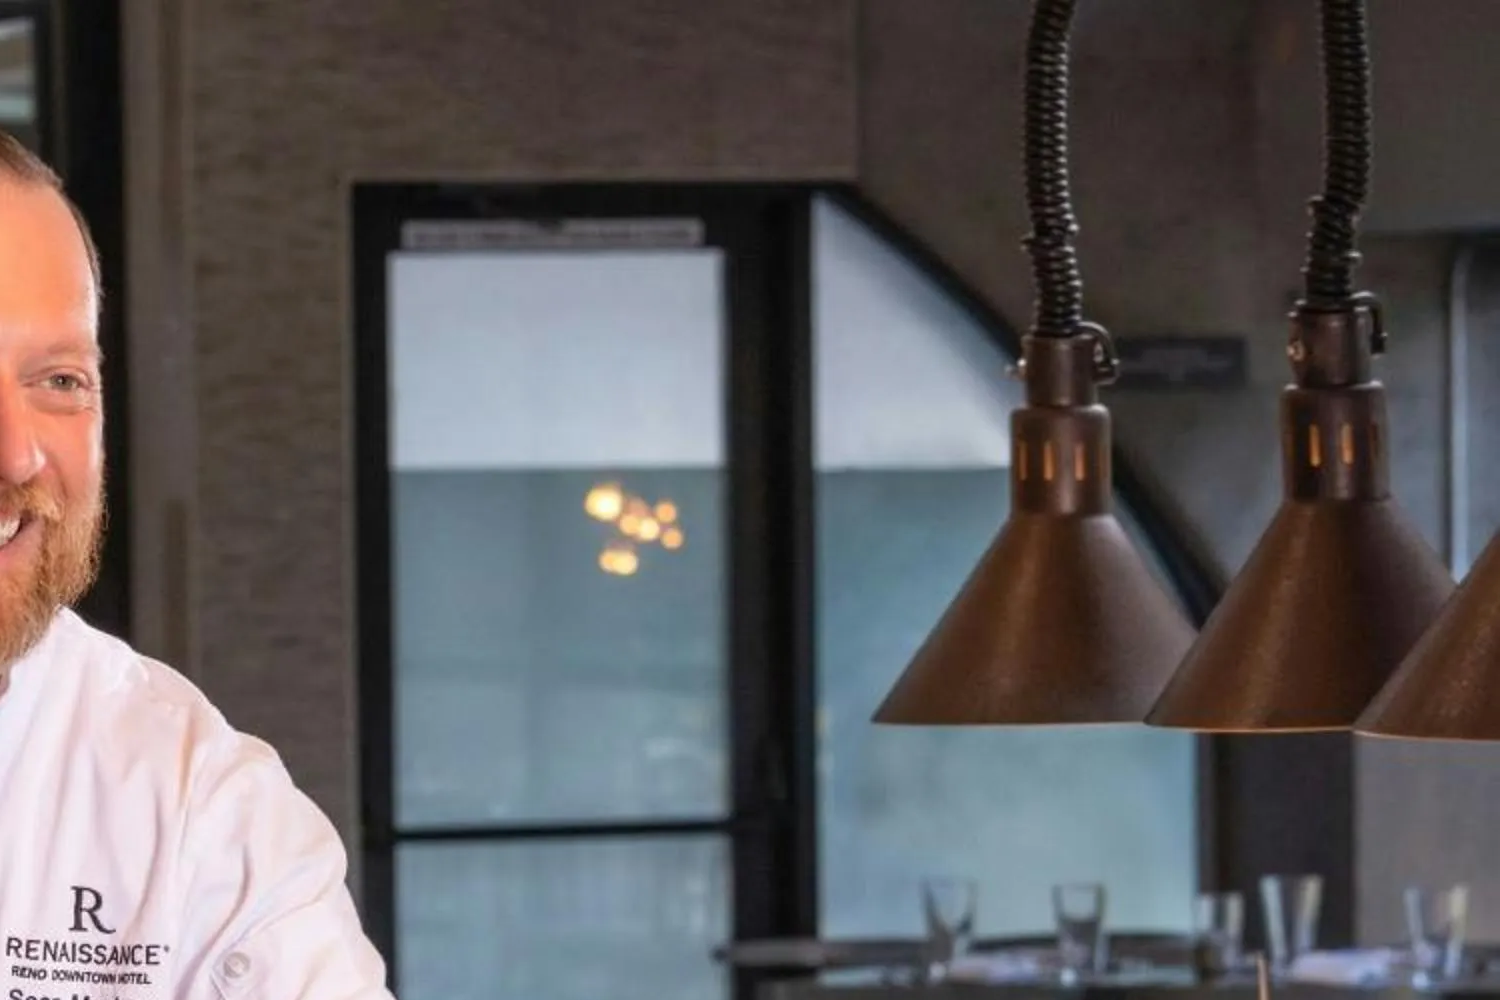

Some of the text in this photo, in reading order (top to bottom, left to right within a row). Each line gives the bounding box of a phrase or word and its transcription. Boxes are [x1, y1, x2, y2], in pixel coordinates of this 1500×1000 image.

[68, 885, 116, 934] R
[5, 936, 161, 966] RENAISSANCE
[11, 965, 47, 981] RENO
[51, 969, 116, 985] DOWNTOWN
